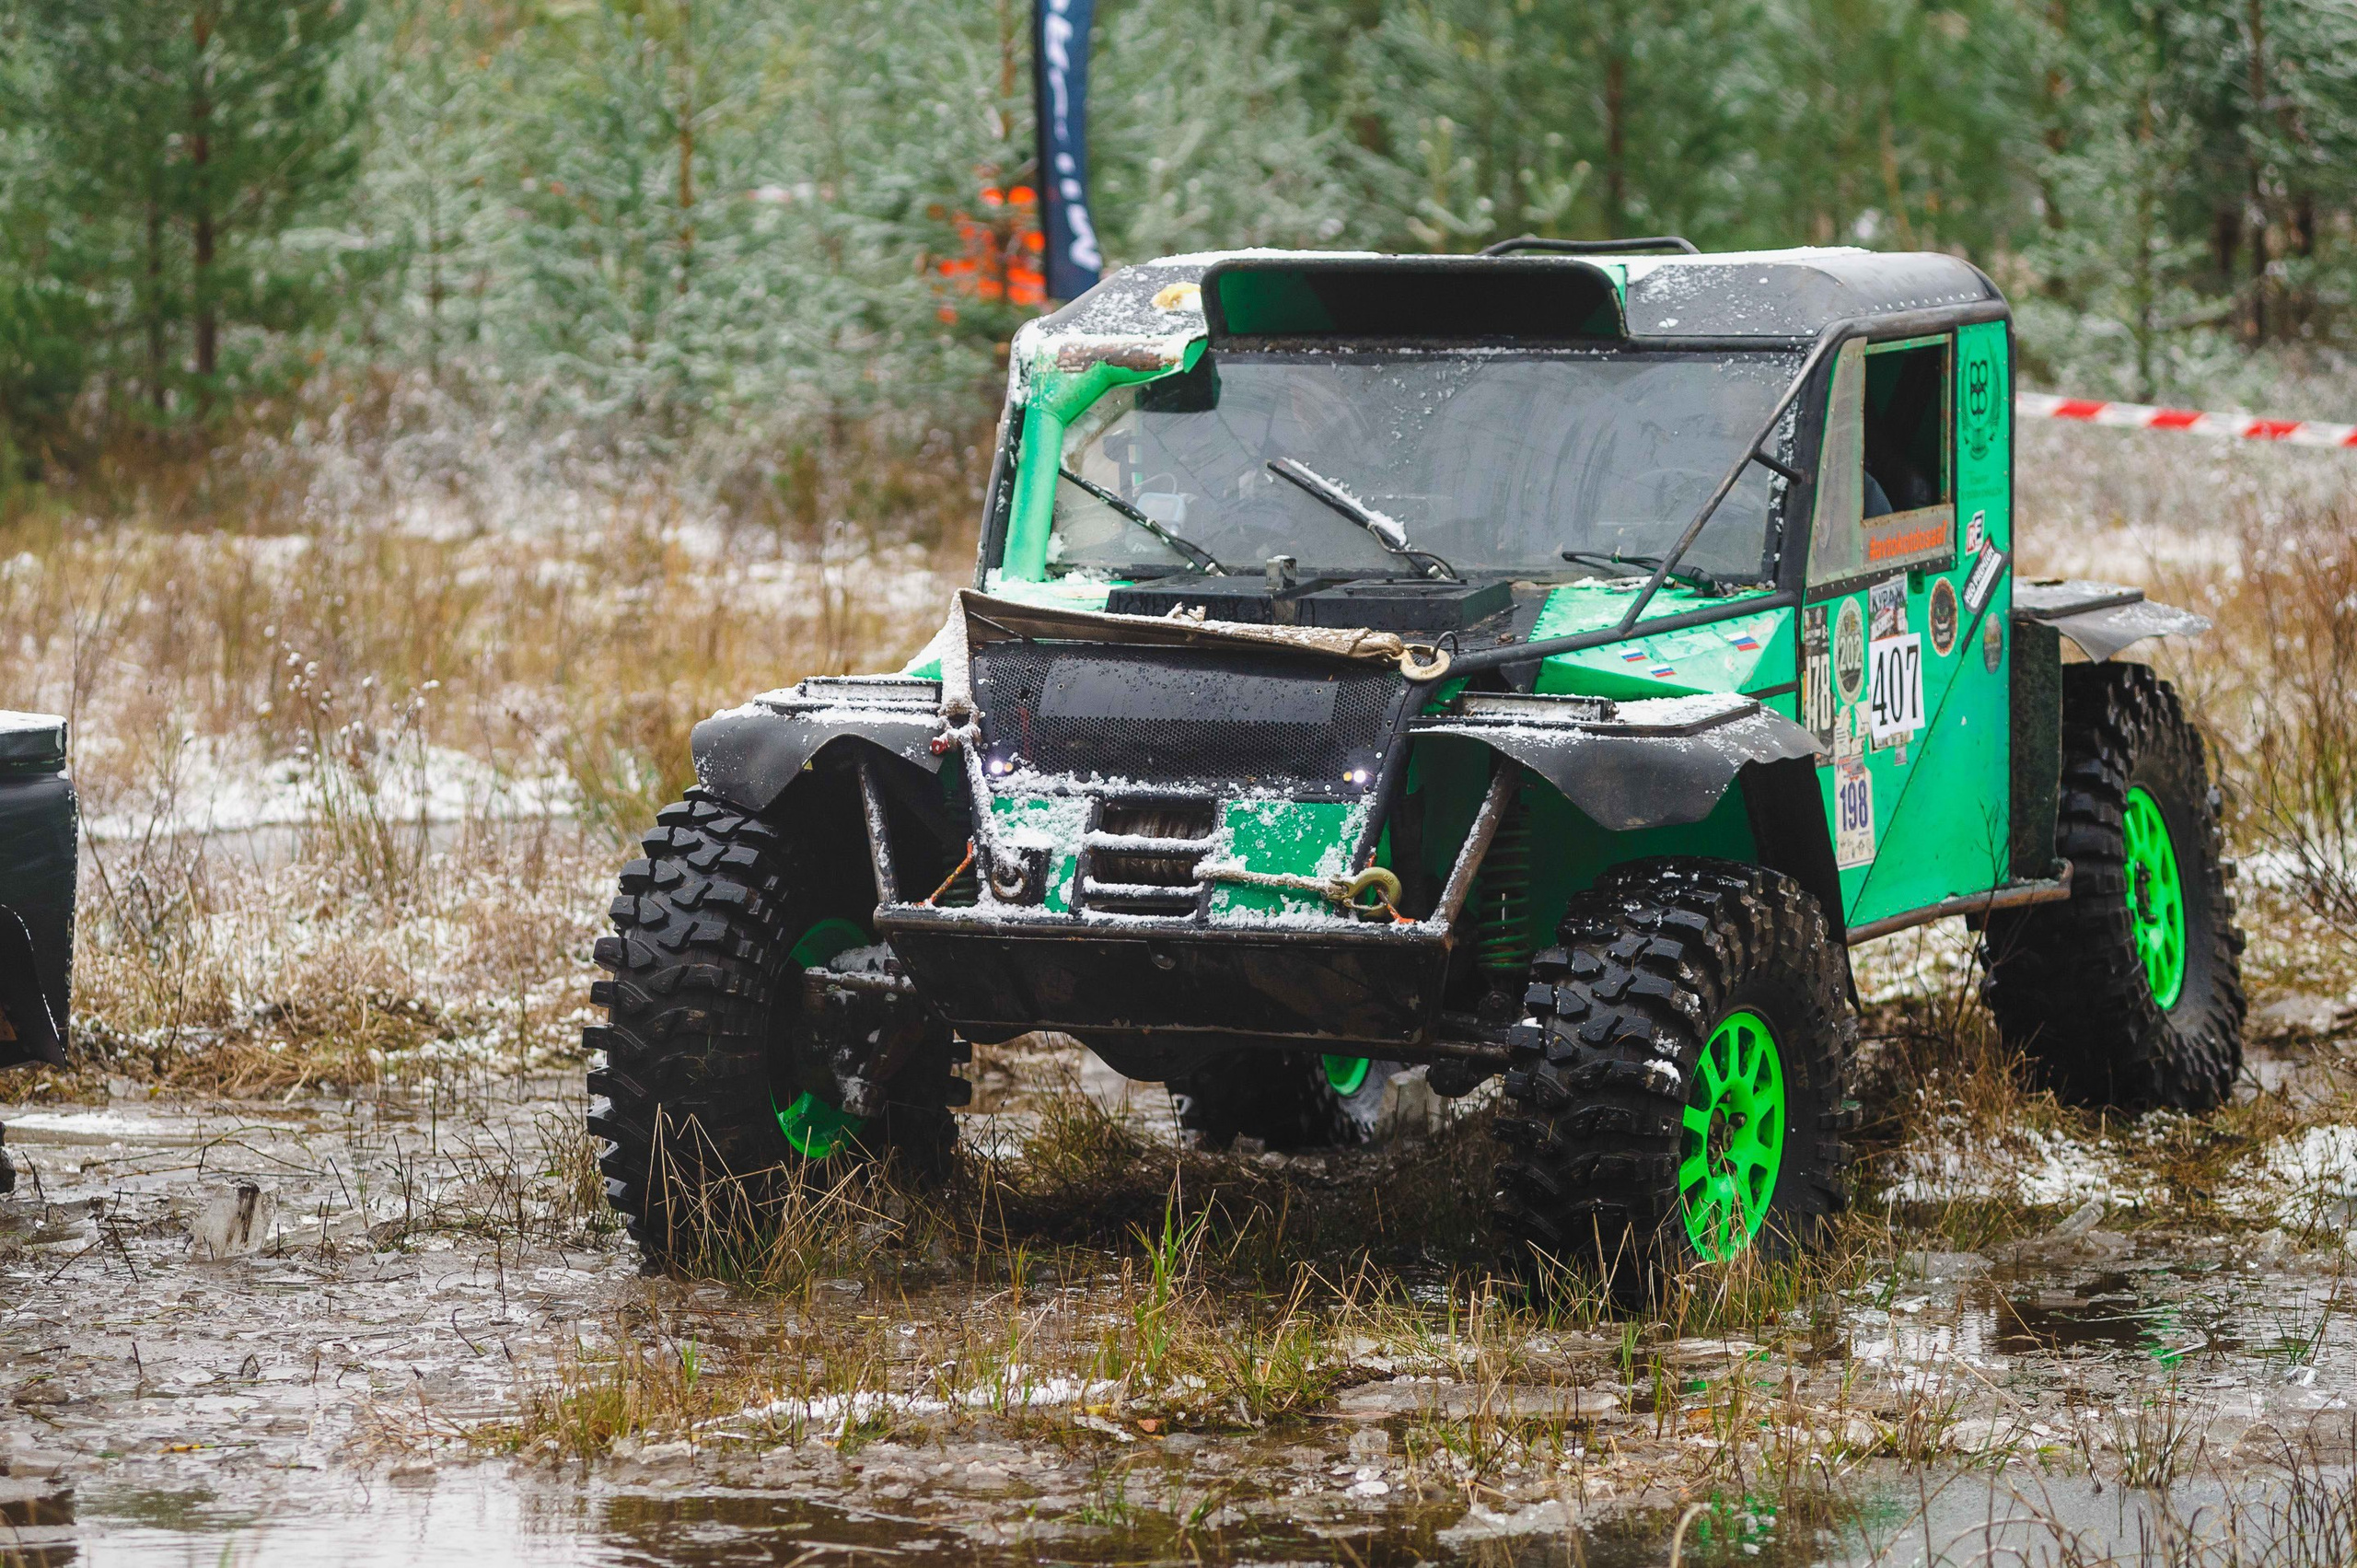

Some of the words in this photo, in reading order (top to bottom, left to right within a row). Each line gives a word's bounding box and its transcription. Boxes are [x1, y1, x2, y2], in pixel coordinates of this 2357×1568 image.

[1840, 633, 1862, 671] 202
[1872, 645, 1919, 726] 407
[1840, 780, 1868, 831] 198
